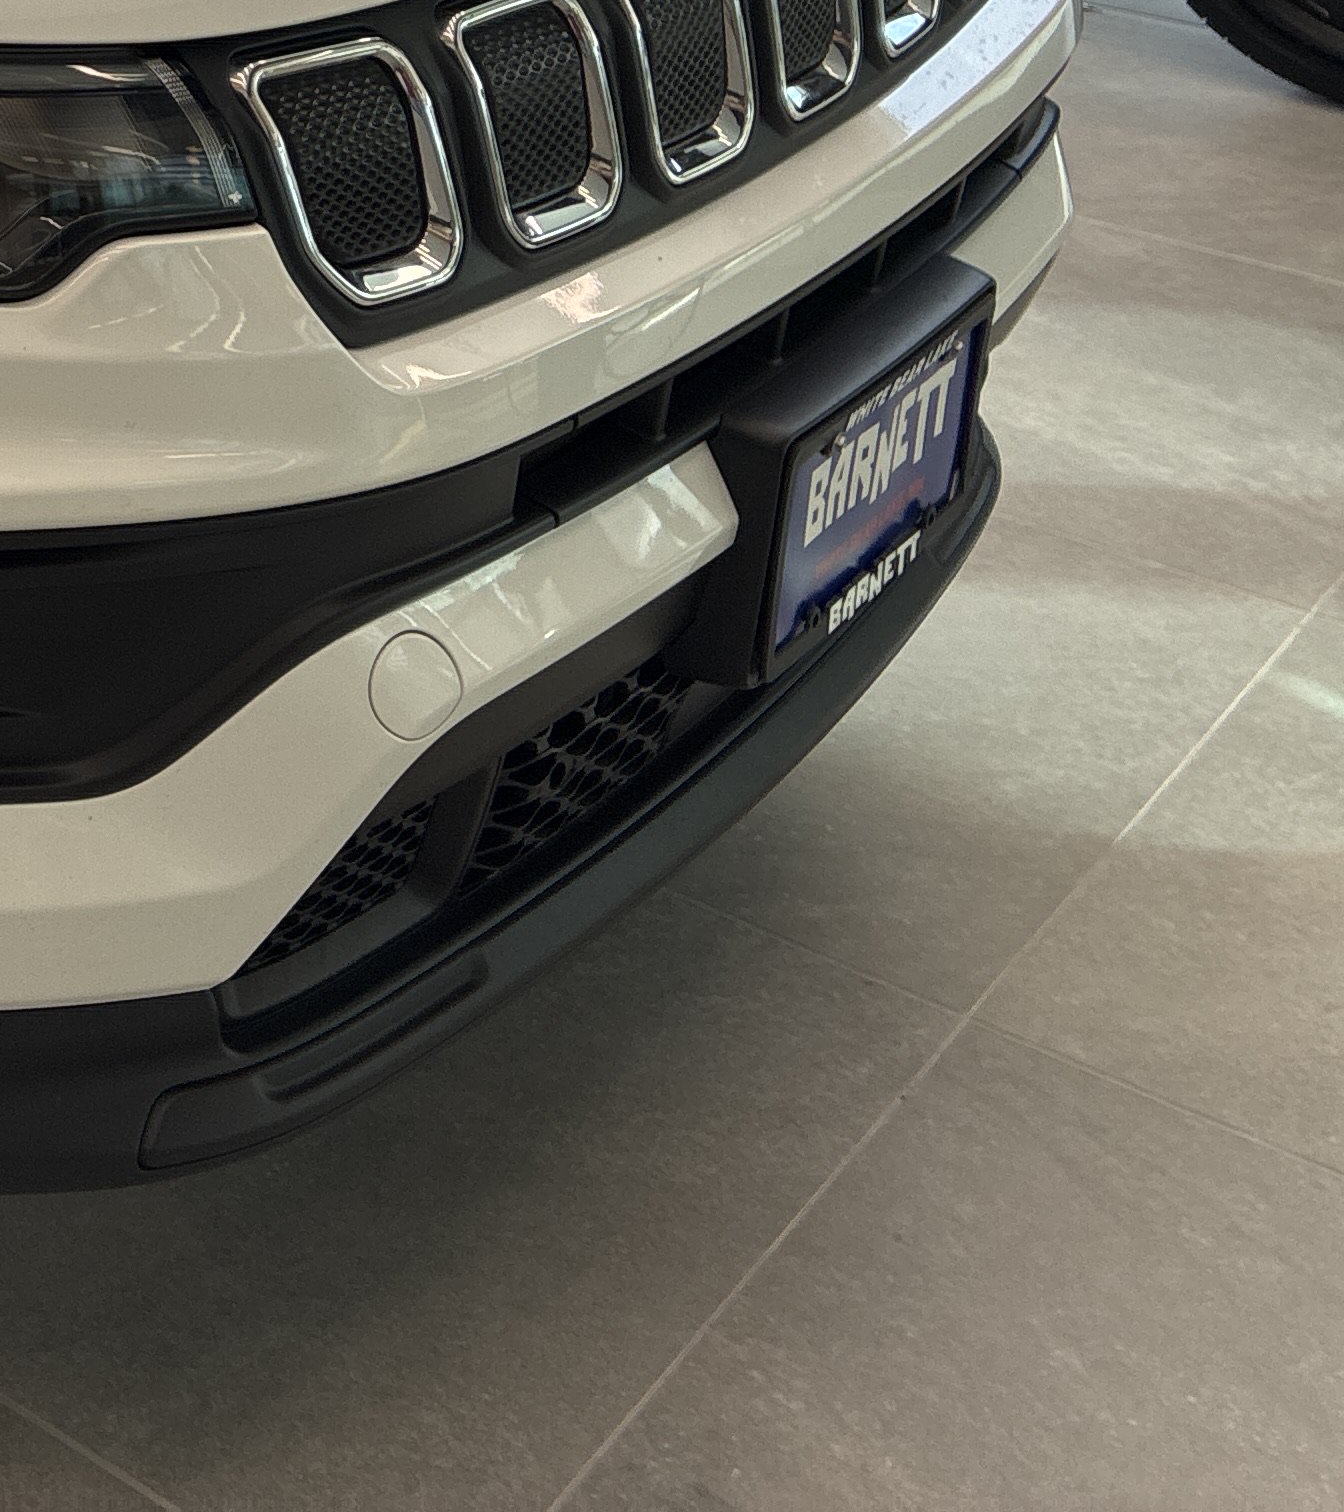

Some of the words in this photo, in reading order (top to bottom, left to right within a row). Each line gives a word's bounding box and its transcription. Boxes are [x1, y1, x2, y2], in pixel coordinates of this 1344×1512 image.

[846, 384, 892, 432] WHITE
[889, 357, 926, 399] BEAR
[804, 359, 957, 548] BARNETT
[827, 530, 921, 635] BARNETT
